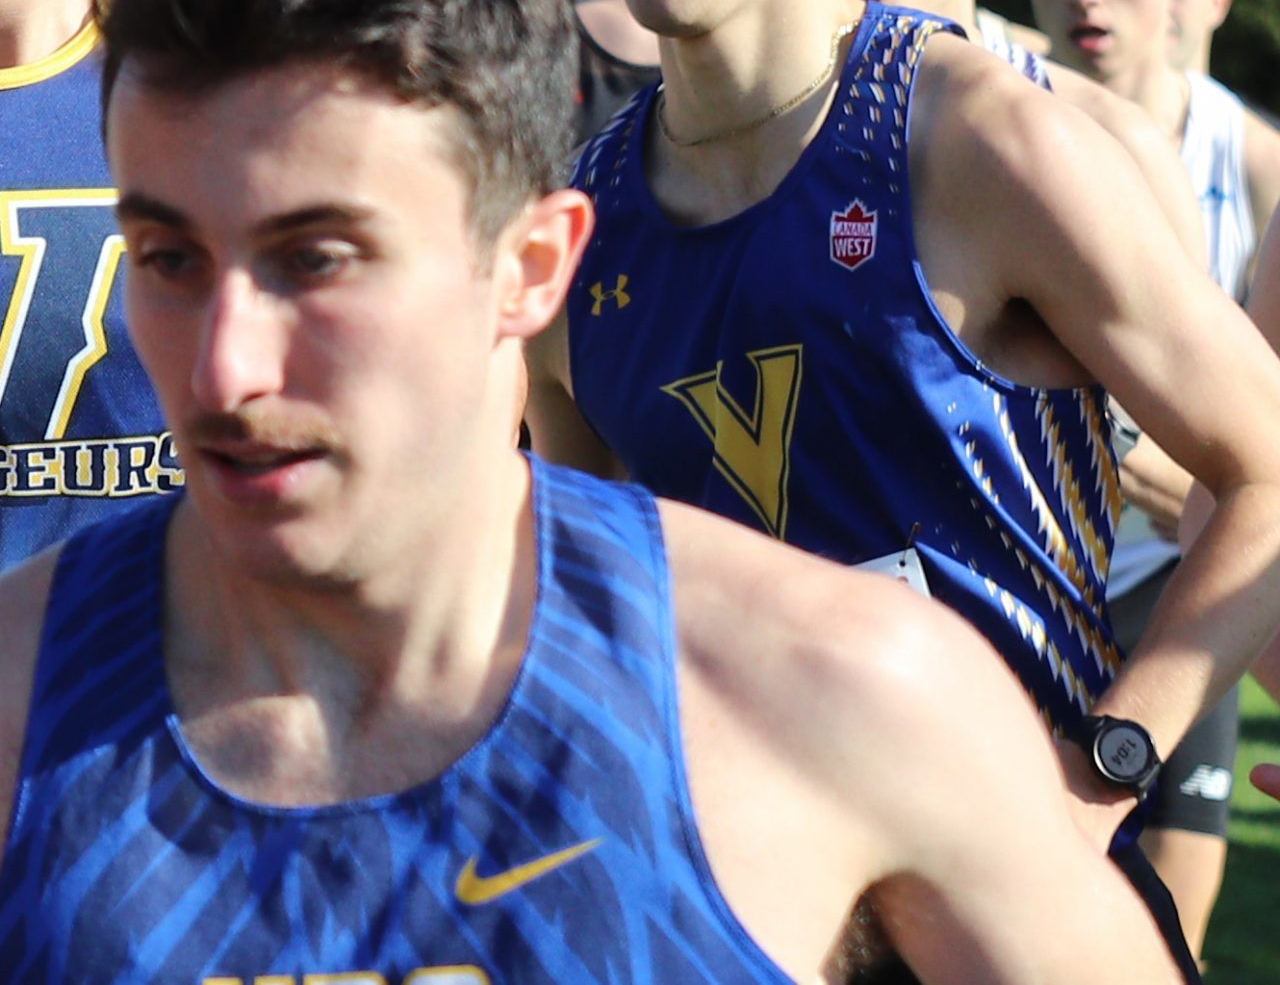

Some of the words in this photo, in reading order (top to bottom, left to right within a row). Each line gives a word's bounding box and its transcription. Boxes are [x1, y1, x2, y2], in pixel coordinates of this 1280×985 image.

[834, 221, 872, 236] CANADA
[833, 237, 871, 257] WEST
[659, 343, 803, 541] V
